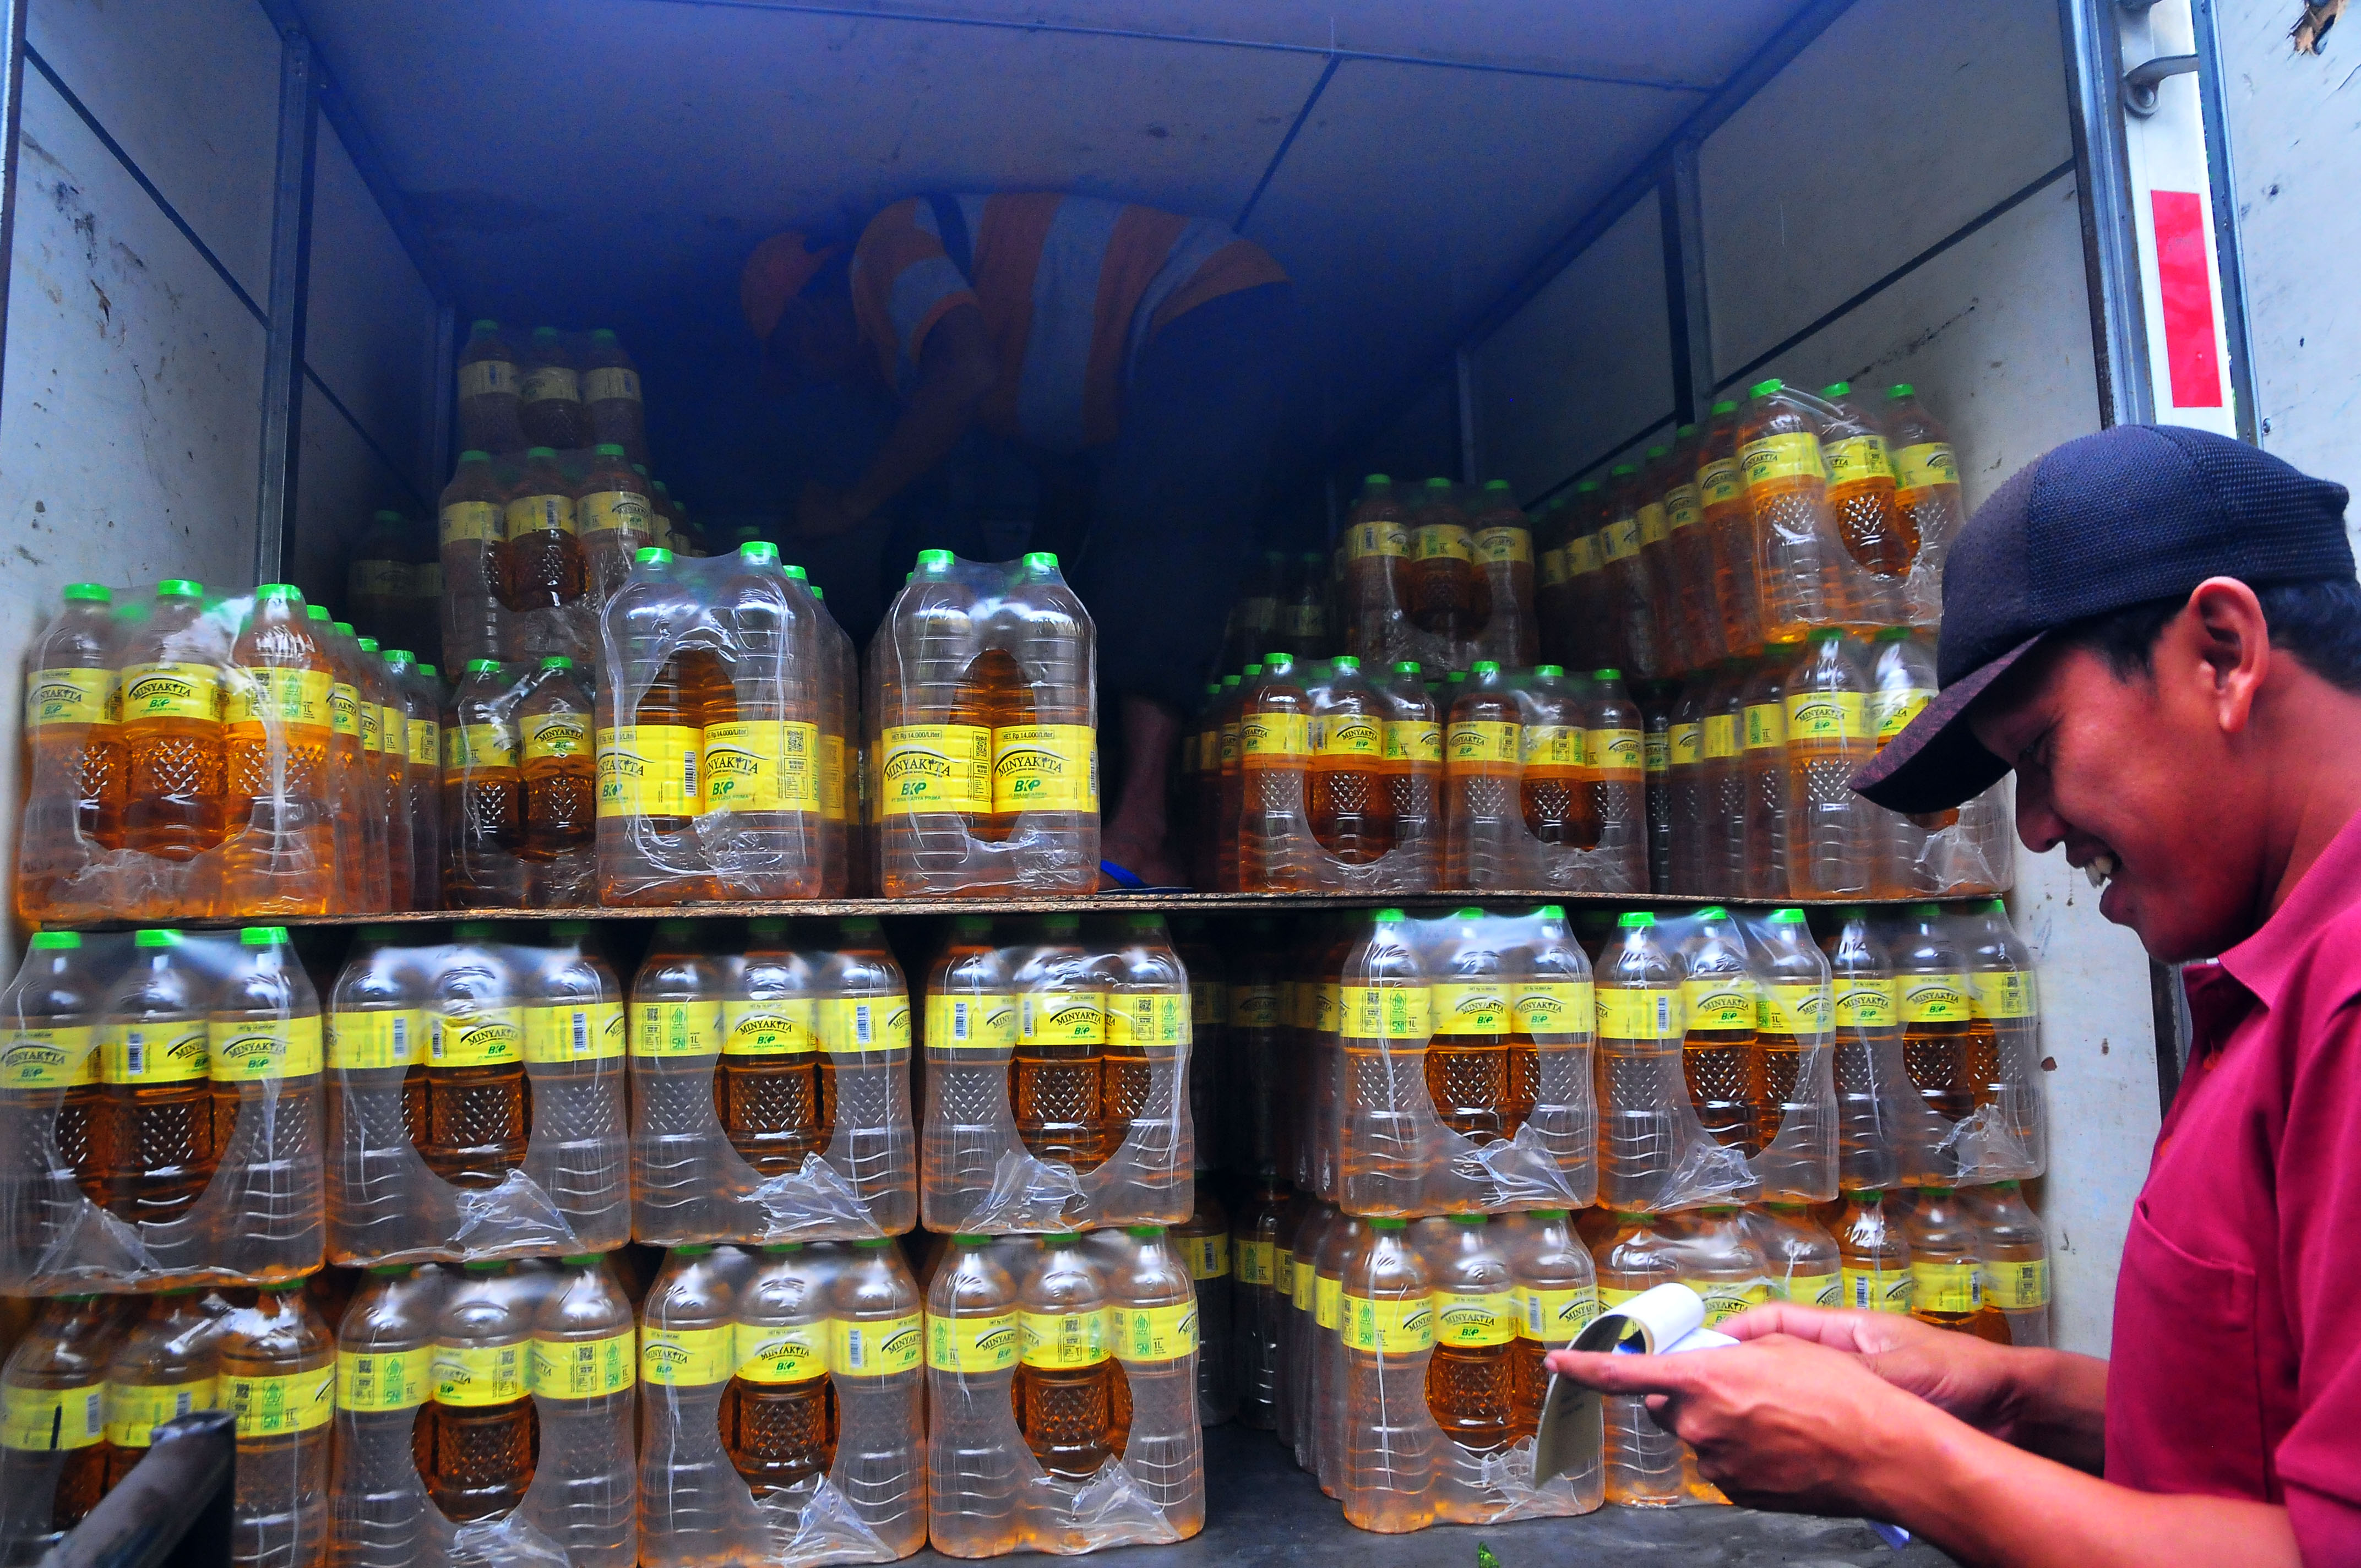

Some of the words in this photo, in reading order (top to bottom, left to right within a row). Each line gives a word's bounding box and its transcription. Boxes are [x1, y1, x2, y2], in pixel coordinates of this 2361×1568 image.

[705, 756, 758, 777] INYAKITA
[886, 758, 950, 781] MINYAKITA
[998, 756, 1062, 777] MINYAKITA
[603, 784, 622, 797] BKP
[712, 781, 735, 795] BKP
[901, 782, 926, 795] BKP
[1014, 780, 1041, 792] BKP
